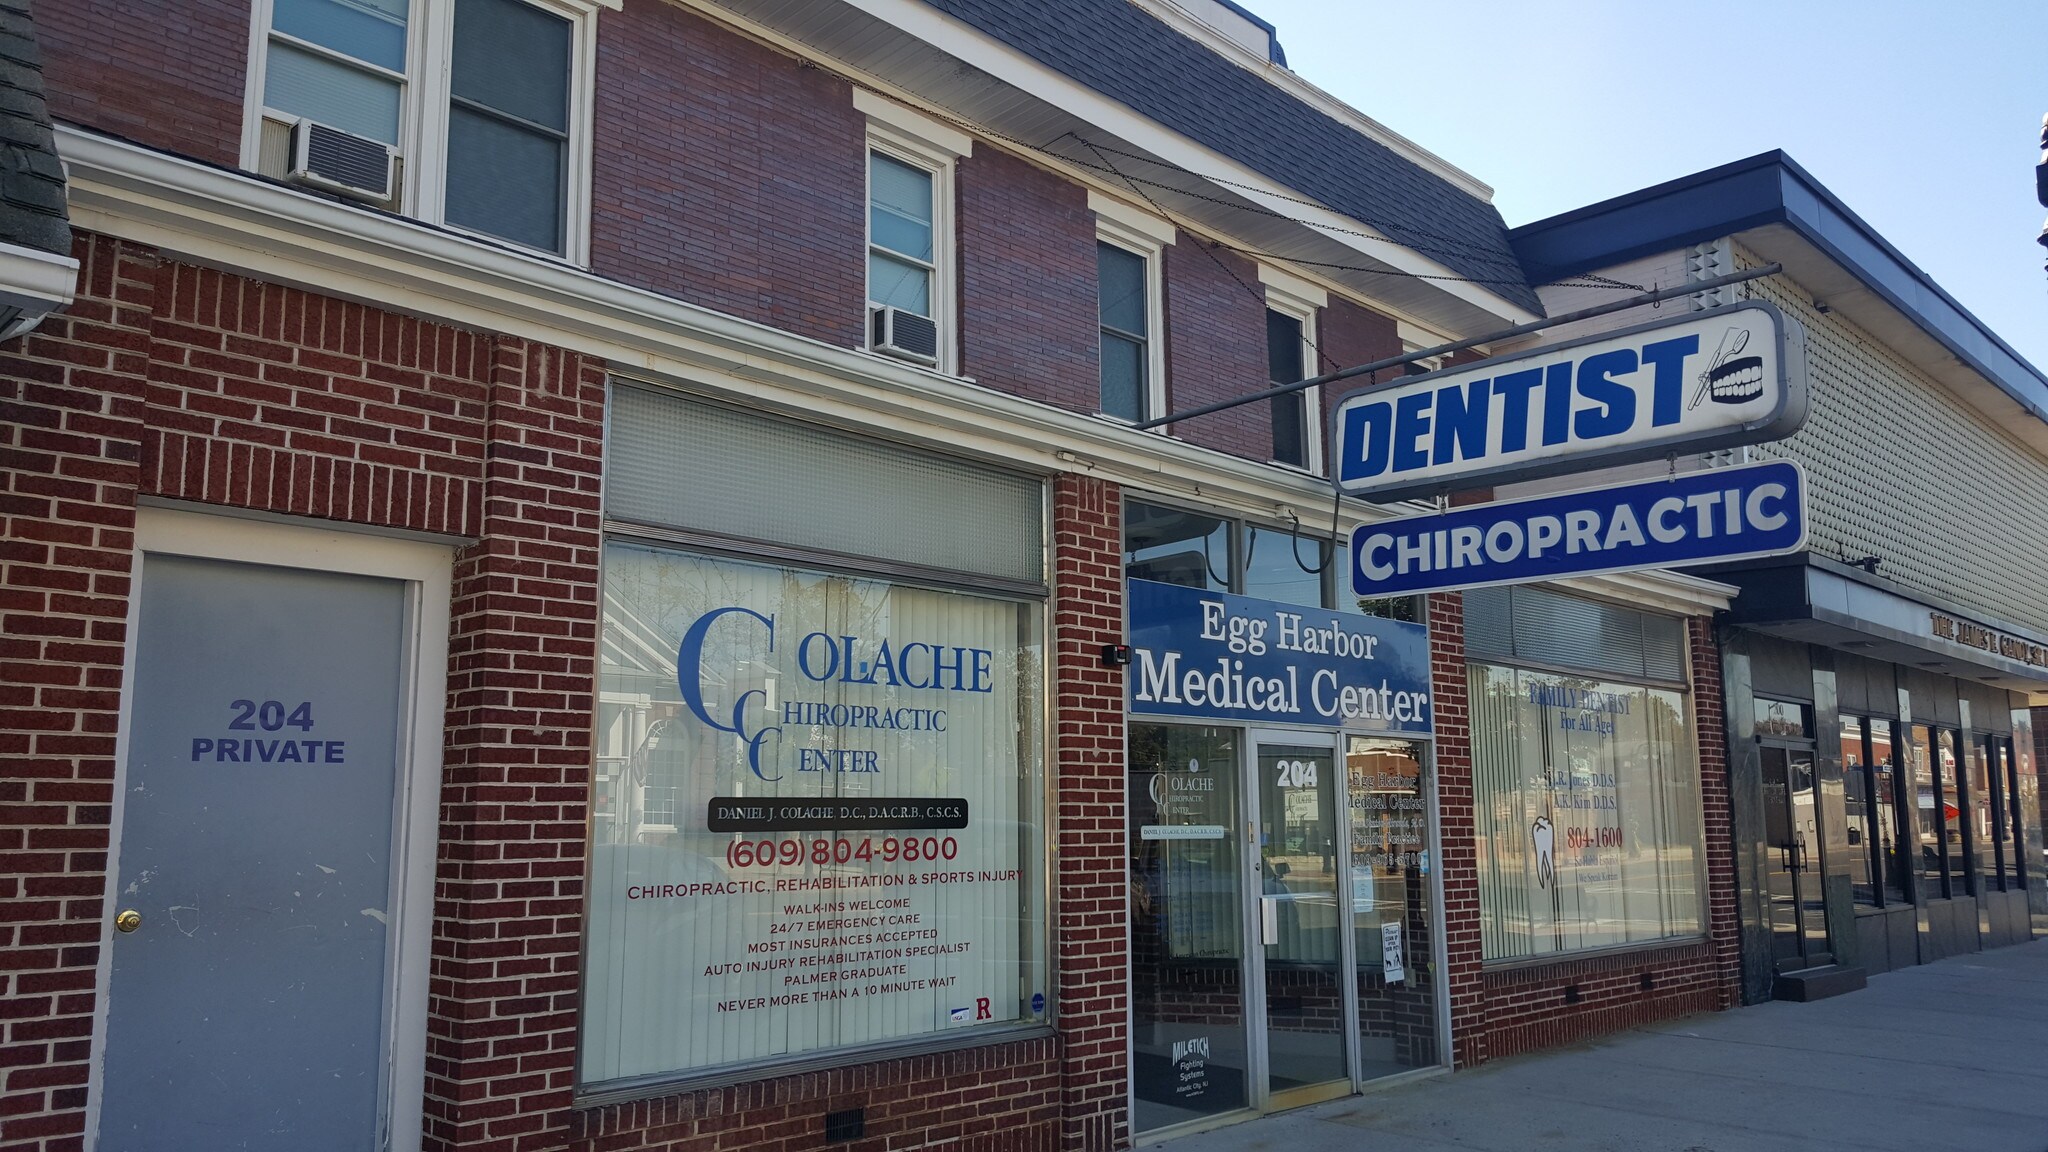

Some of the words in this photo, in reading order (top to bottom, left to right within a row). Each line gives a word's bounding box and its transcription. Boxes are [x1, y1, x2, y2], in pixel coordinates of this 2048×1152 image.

[1341, 334, 1699, 482] DENTIST
[1359, 483, 1789, 581] CHIROPRACTIC
[1199, 600, 1269, 656] Egg
[1275, 611, 1378, 660] Harbor
[1930, 612, 1954, 640] THE
[1135, 648, 1301, 713] Medical
[1311, 668, 1428, 722] Center
[1529, 682, 1577, 709] FAMILY
[1581, 690, 1631, 715] DENTIST
[228, 699, 314, 732] 204
[1560, 711, 1576, 730] For
[1579, 714, 1592, 732] All
[1594, 717, 1615, 739] Ages
[191, 738, 345, 763] PRIVATE
[1276, 760, 1317, 788] 204
[1351, 771, 1375, 790] Egg
[1377, 771, 1417, 788] Harbor
[1592, 773, 1616, 788] D.D.S.
[718, 807, 766, 820] DANIEL
[767, 807, 777, 822] J.
[840, 807, 866, 821] D.C.,
[926, 806, 962, 819] C.S.C.S.
[1388, 793, 1426, 810] Center
[1574, 794, 1591, 809] Kim
[1594, 795, 1617, 810] D.D.S.
[1567, 826, 1623, 849] 804-1600
[627, 878, 771, 900] CHIROPRACTIC,
[776, 873, 904, 892] REHABILITATION
[908, 874, 917, 886] &
[921, 871, 974, 885] SPORTS
[977, 869, 1024, 882] INJURY
[783, 902, 846, 916] WALK-INS
[848, 898, 911, 912] WELCOME
[770, 921, 804, 935] 24/7
[807, 915, 886, 932] EMERGENCY
[888, 913, 921, 926] CARE
[747, 941, 787, 954] MOST
[789, 934, 873, 951] INSURANCES
[875, 928, 938, 943] ACCEPTED
[703, 963, 743, 977] AUTO
[746, 958, 796, 974] INJURY
[799, 949, 902, 968] REHABILITATION
[905, 942, 971, 959] SPECIALIST
[783, 971, 838, 986] PALMER
[840, 965, 907, 981] GRADUATE
[717, 998, 766, 1013] NEVER
[769, 994, 810, 1008] MORE
[813, 989, 849, 1003] THAN
[851, 987, 860, 999] A
[864, 985, 878, 996] 10
[880, 980, 925, 995] MINUTE
[927, 976, 956, 990] WAIT
[976, 997, 991, 1020] R
[1172, 1036, 1209, 1067] MILETICH
[1180, 1059, 1204, 1071] Fighting
[1180, 1070, 1205, 1082] Systems
